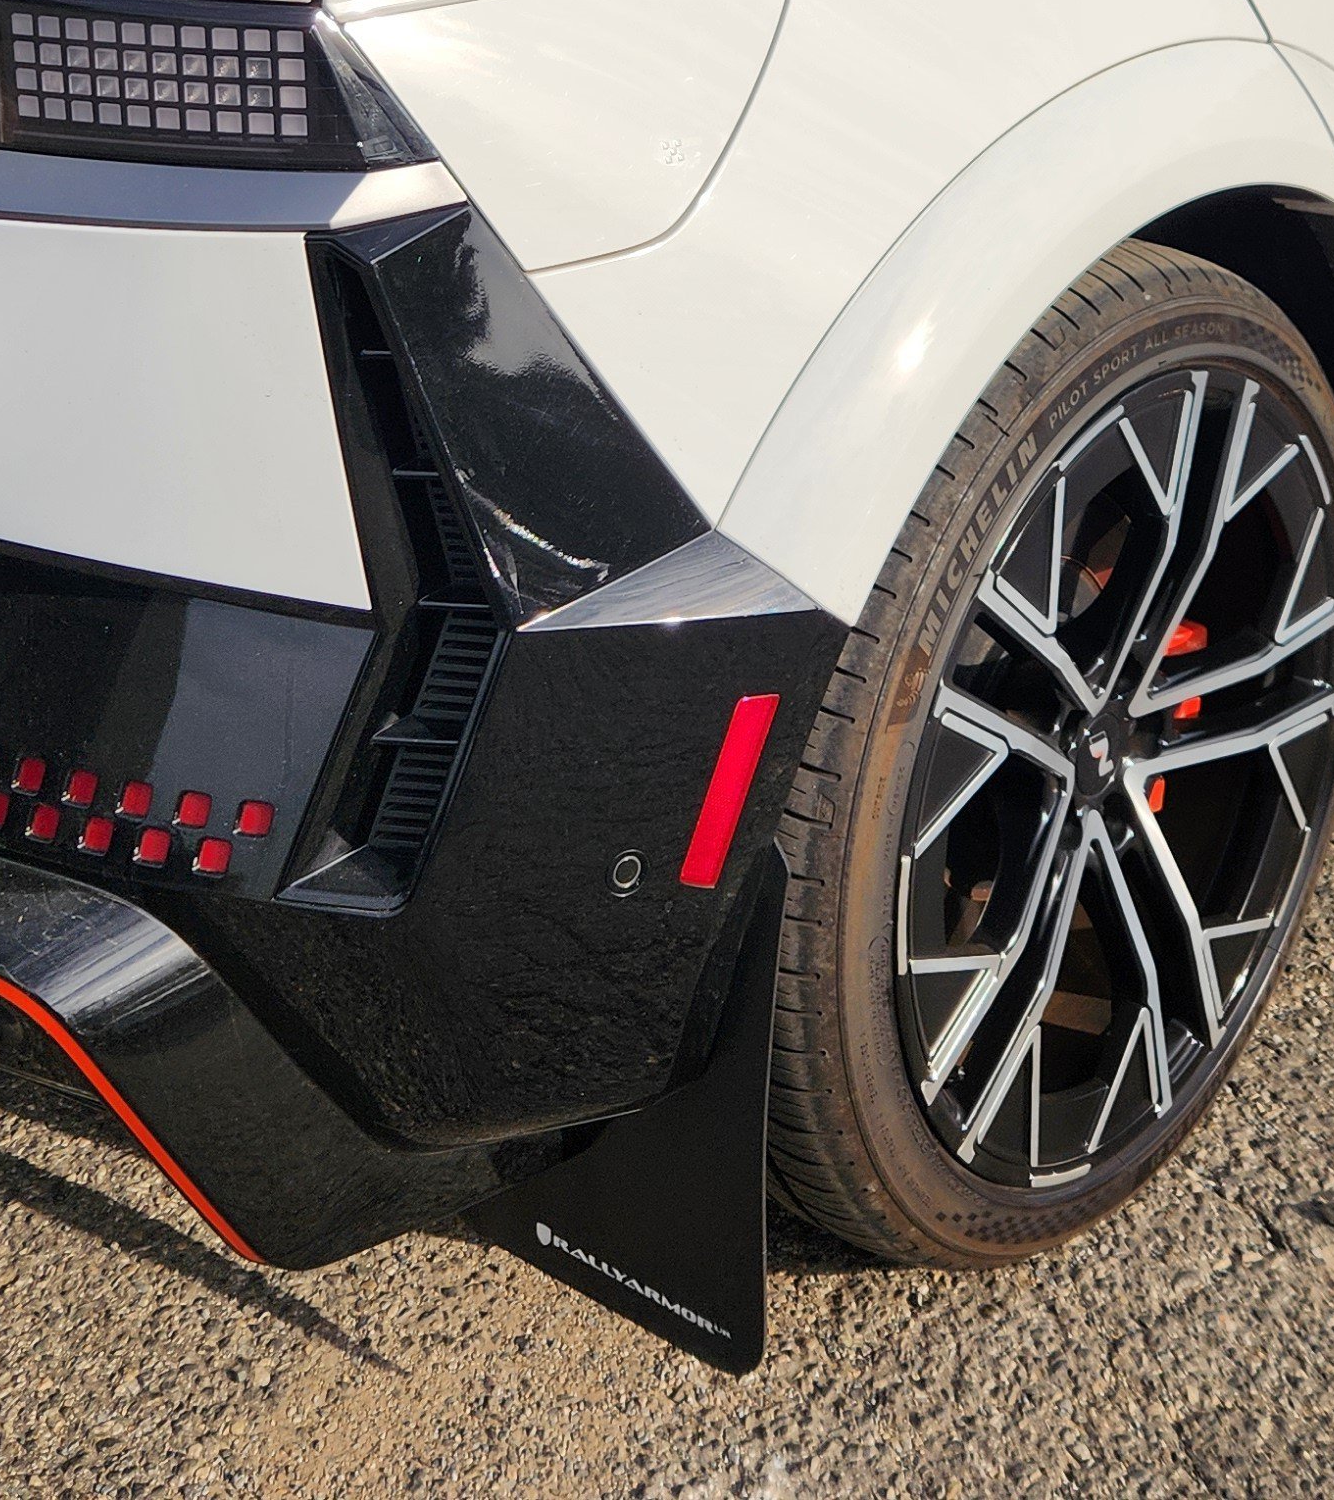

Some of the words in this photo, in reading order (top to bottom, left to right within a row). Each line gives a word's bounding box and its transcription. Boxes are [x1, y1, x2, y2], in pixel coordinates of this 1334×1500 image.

[918, 431, 1038, 658] MICHELIN
[1048, 380, 1089, 430] PILOT
[1093, 344, 1139, 387] SPORT
[1144, 334, 1169, 352] ALL
[552, 1234, 716, 1336] RALLYARMOR
